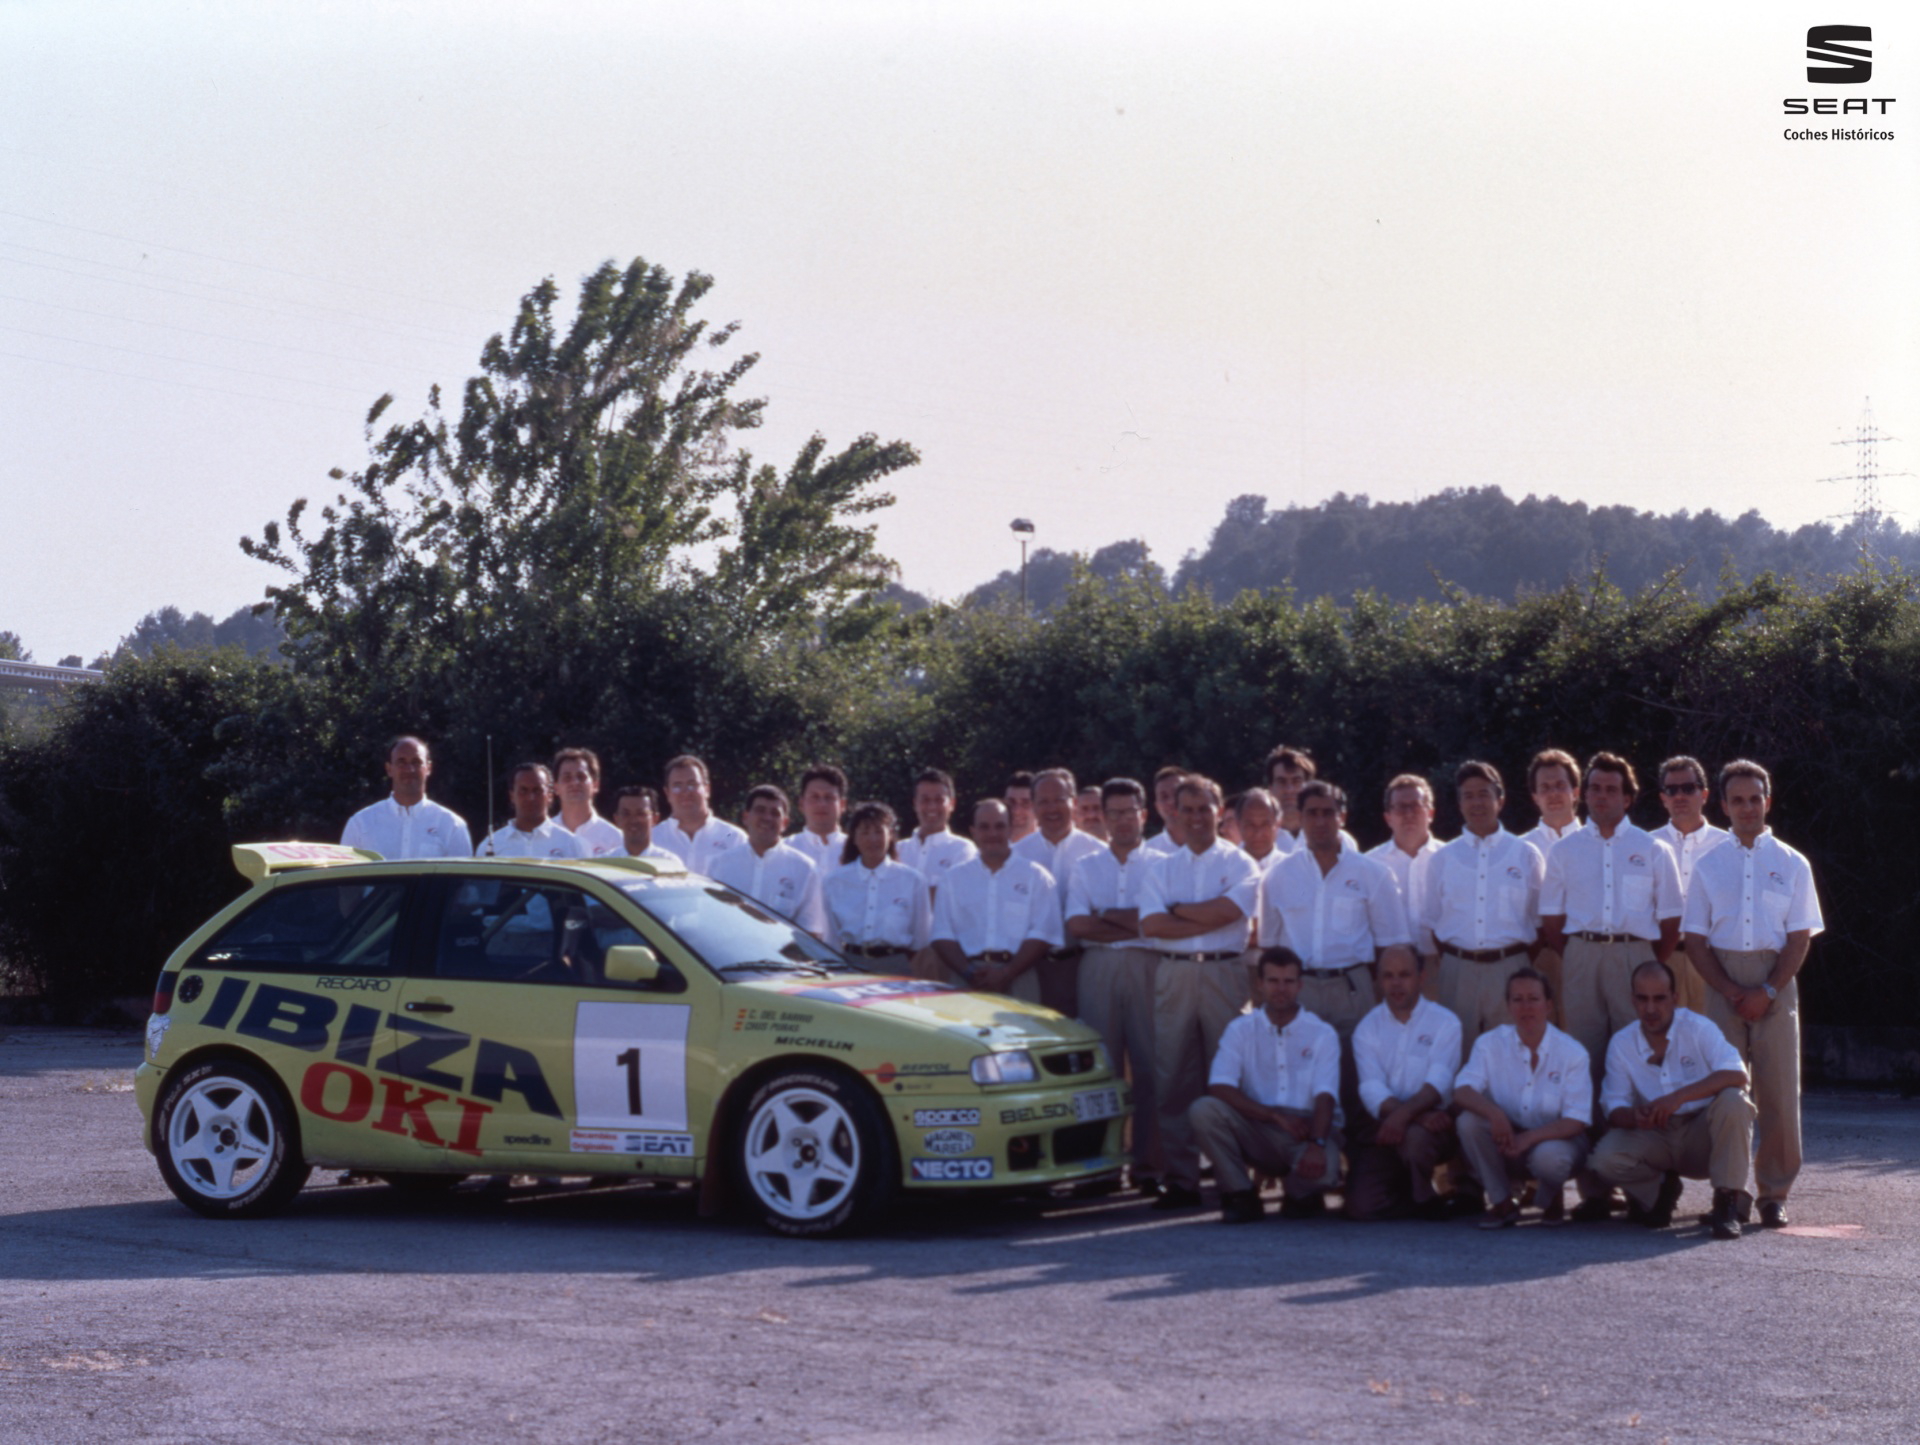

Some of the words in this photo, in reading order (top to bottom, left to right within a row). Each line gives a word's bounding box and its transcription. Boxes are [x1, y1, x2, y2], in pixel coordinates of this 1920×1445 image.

[316, 976, 391, 992] RECARO
[199, 976, 565, 1122] IBIZA
[774, 1036, 854, 1051] MICHELIN
[616, 1047, 643, 1116] 1
[300, 1061, 493, 1158] OKI
[914, 1110, 980, 1127] sparco
[503, 1134, 552, 1147] speedline
[625, 1134, 691, 1154] SEAT
[913, 1159, 992, 1179] NECTO
